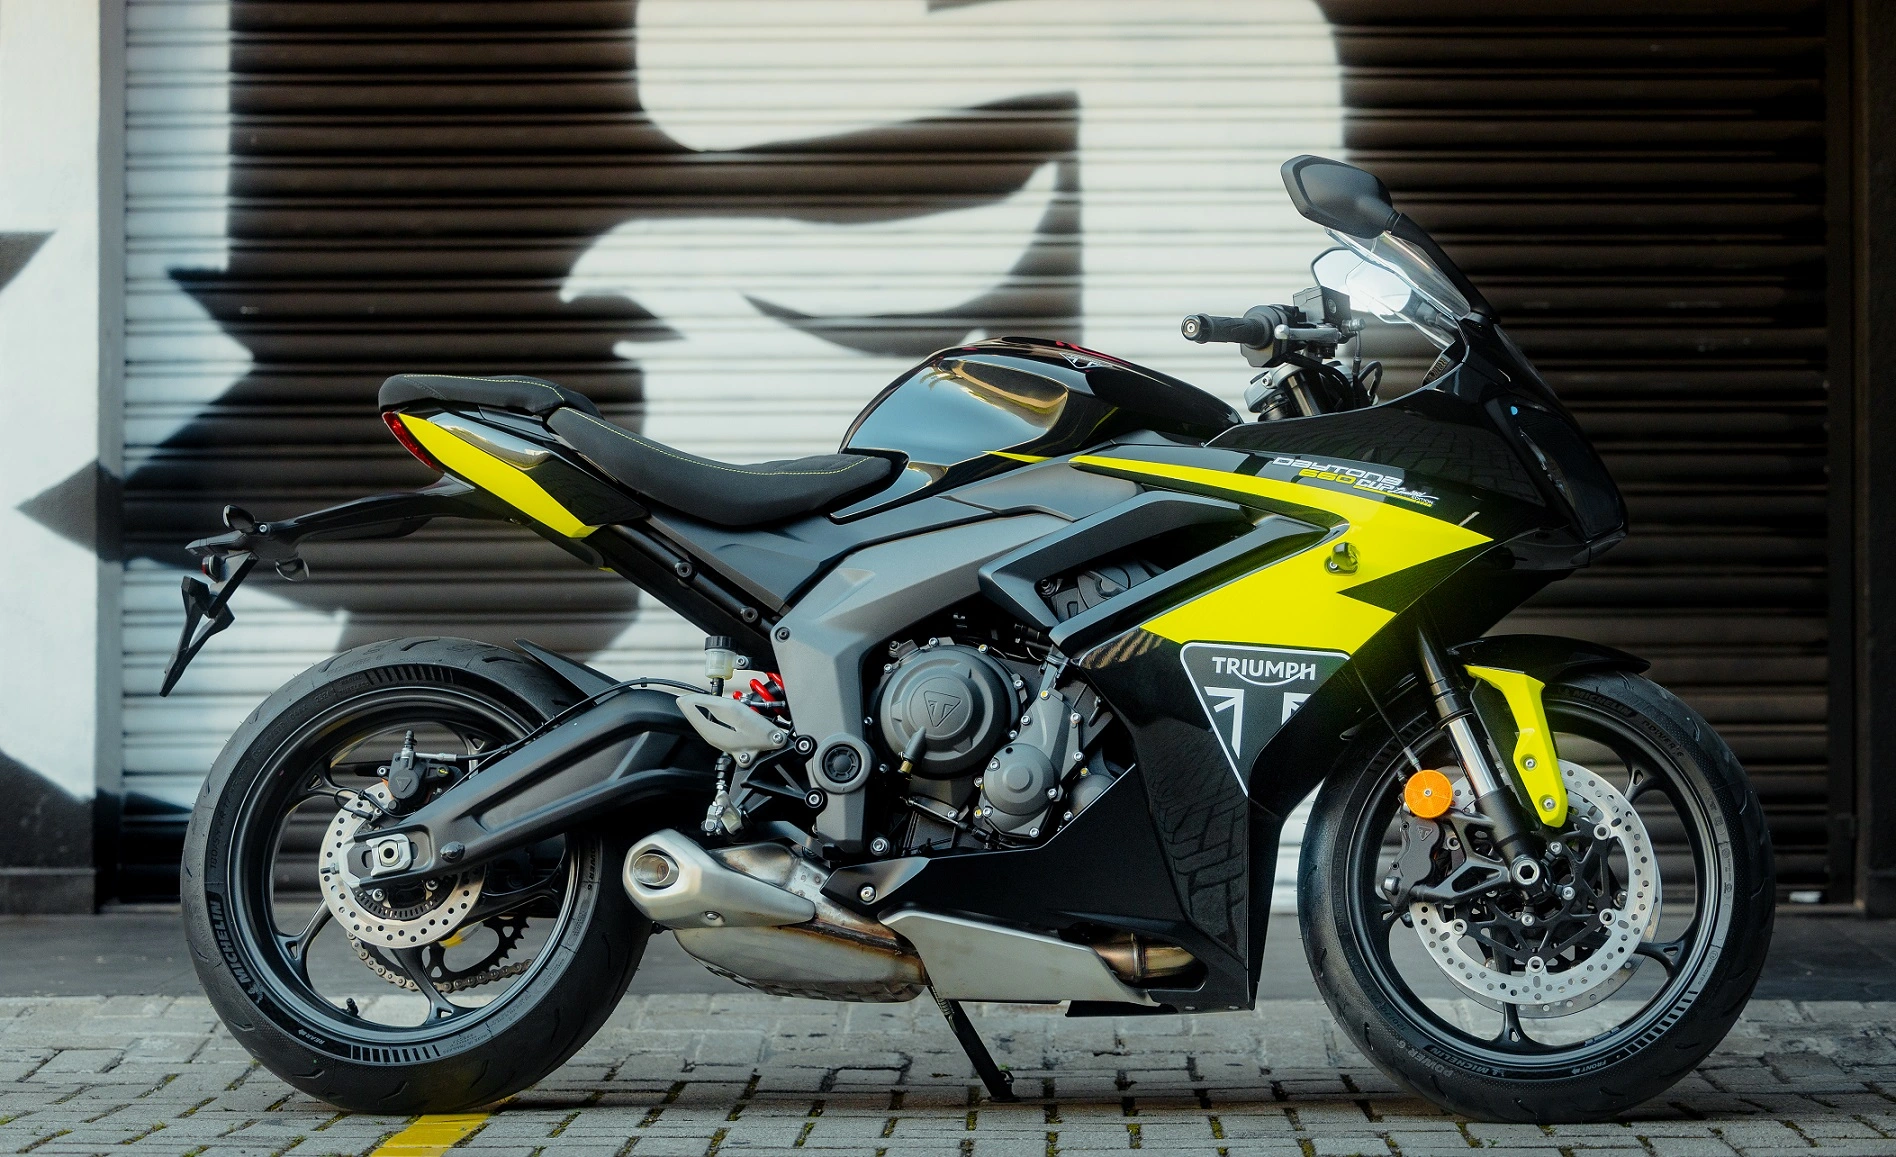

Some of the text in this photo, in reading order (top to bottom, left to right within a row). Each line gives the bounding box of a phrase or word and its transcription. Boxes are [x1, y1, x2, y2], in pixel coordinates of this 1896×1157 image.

[1299, 468, 1396, 492] 660 CUP
[1212, 656, 1316, 685] TRIUMPH
[1573, 690, 1632, 716] MICHELIN
[1641, 720, 1678, 749] POWER
[211, 901, 250, 984] MICHELIN
[306, 1033, 326, 1044] REAR
[1396, 1039, 1454, 1078] POWER 6
[1430, 1047, 1490, 1075] MICHELIN
[1580, 1060, 1607, 1072] FRONT
